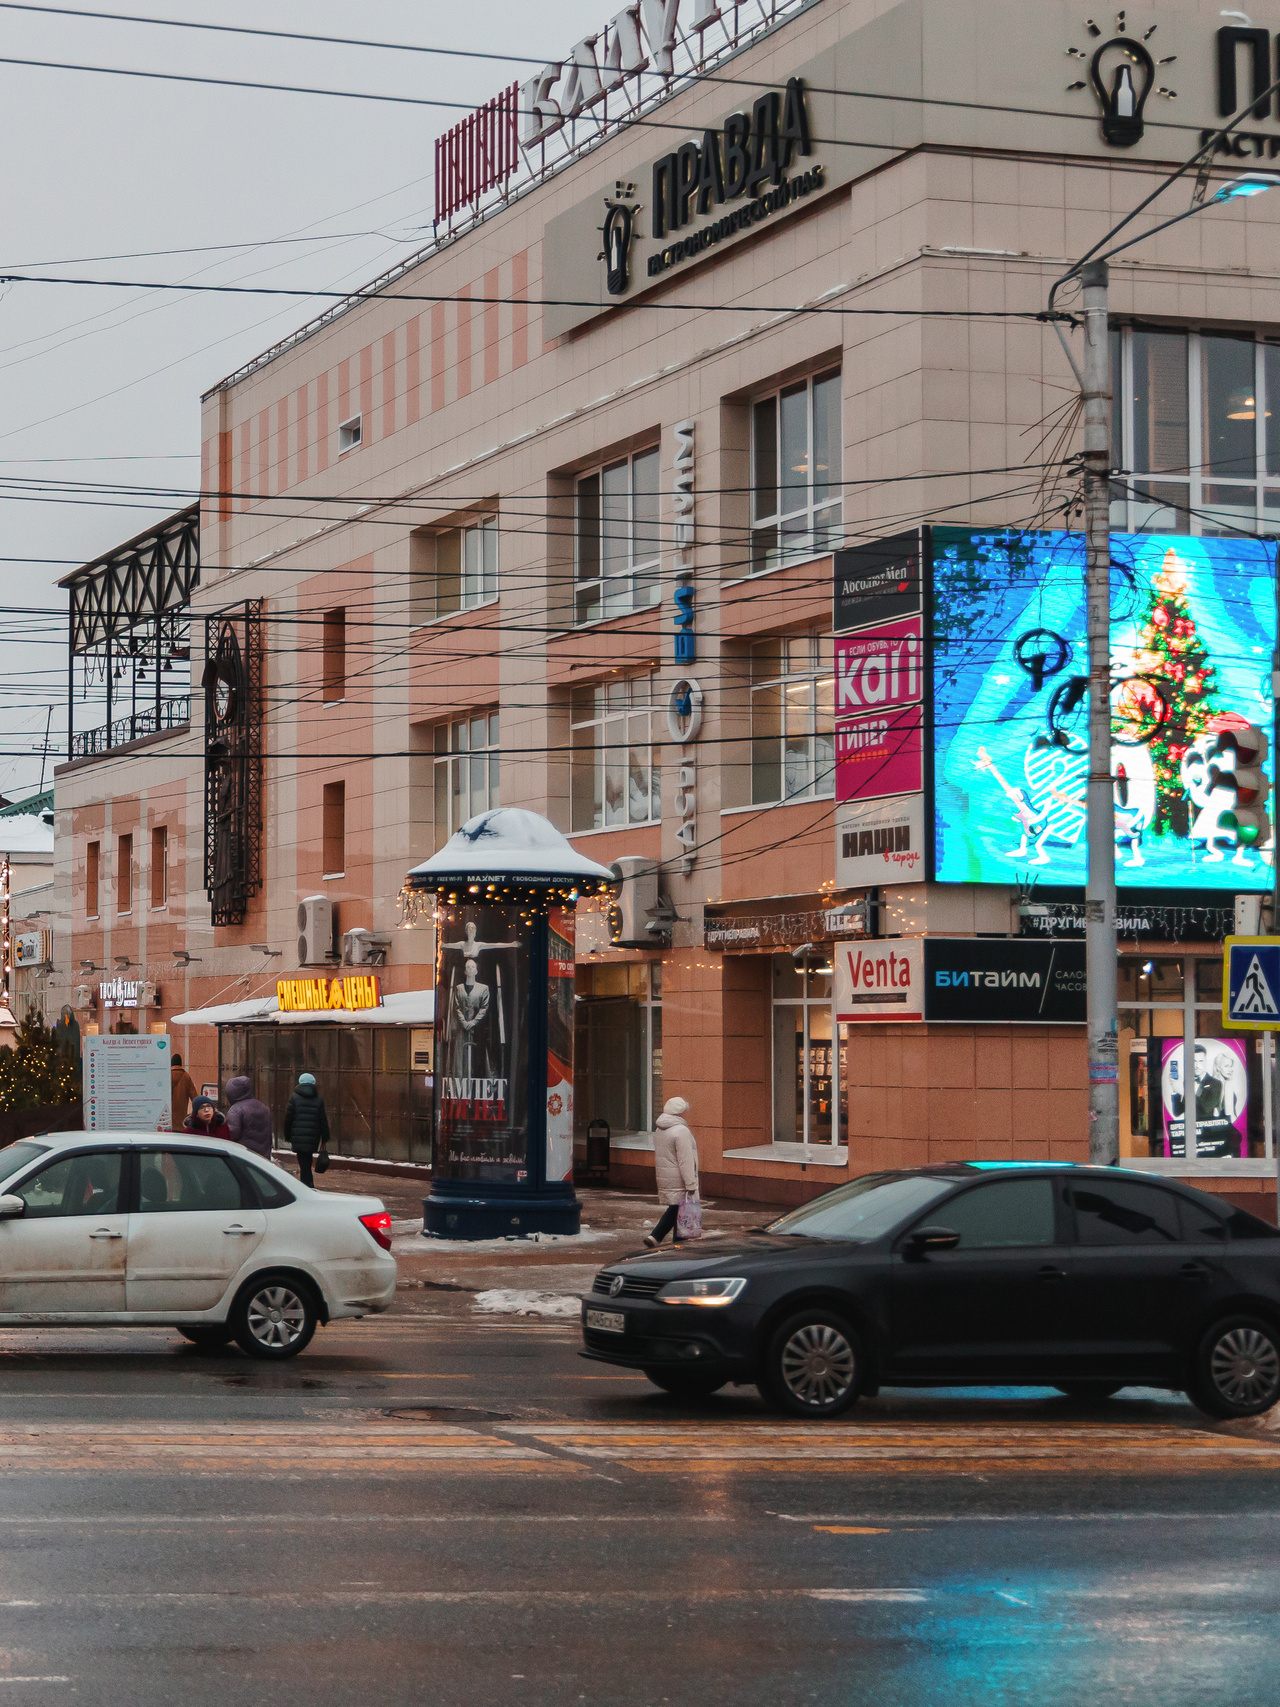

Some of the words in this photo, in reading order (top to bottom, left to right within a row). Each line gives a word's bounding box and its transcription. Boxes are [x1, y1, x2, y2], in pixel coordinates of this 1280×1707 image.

[652, 76, 811, 239] ПРАВДА
[647, 178, 790, 277] ГАСТРОНОМИЧЕСКИЙ
[790, 163, 825, 205] ПАБ
[849, 644, 866, 656] ЕСЛИ
[838, 633, 917, 709] kari
[839, 720, 888, 751] ГИПЕР
[842, 825, 910, 858] НАШИ
[1033, 916, 1150, 930] #ДРУГИЕВИЛА
[847, 951, 910, 988] Venta
[277, 978, 328, 1010] СМЕШНЫЕ
[343, 975, 376, 1012] ЦЕНЫ
[442, 1078, 507, 1100] ГАМЛЕТ
